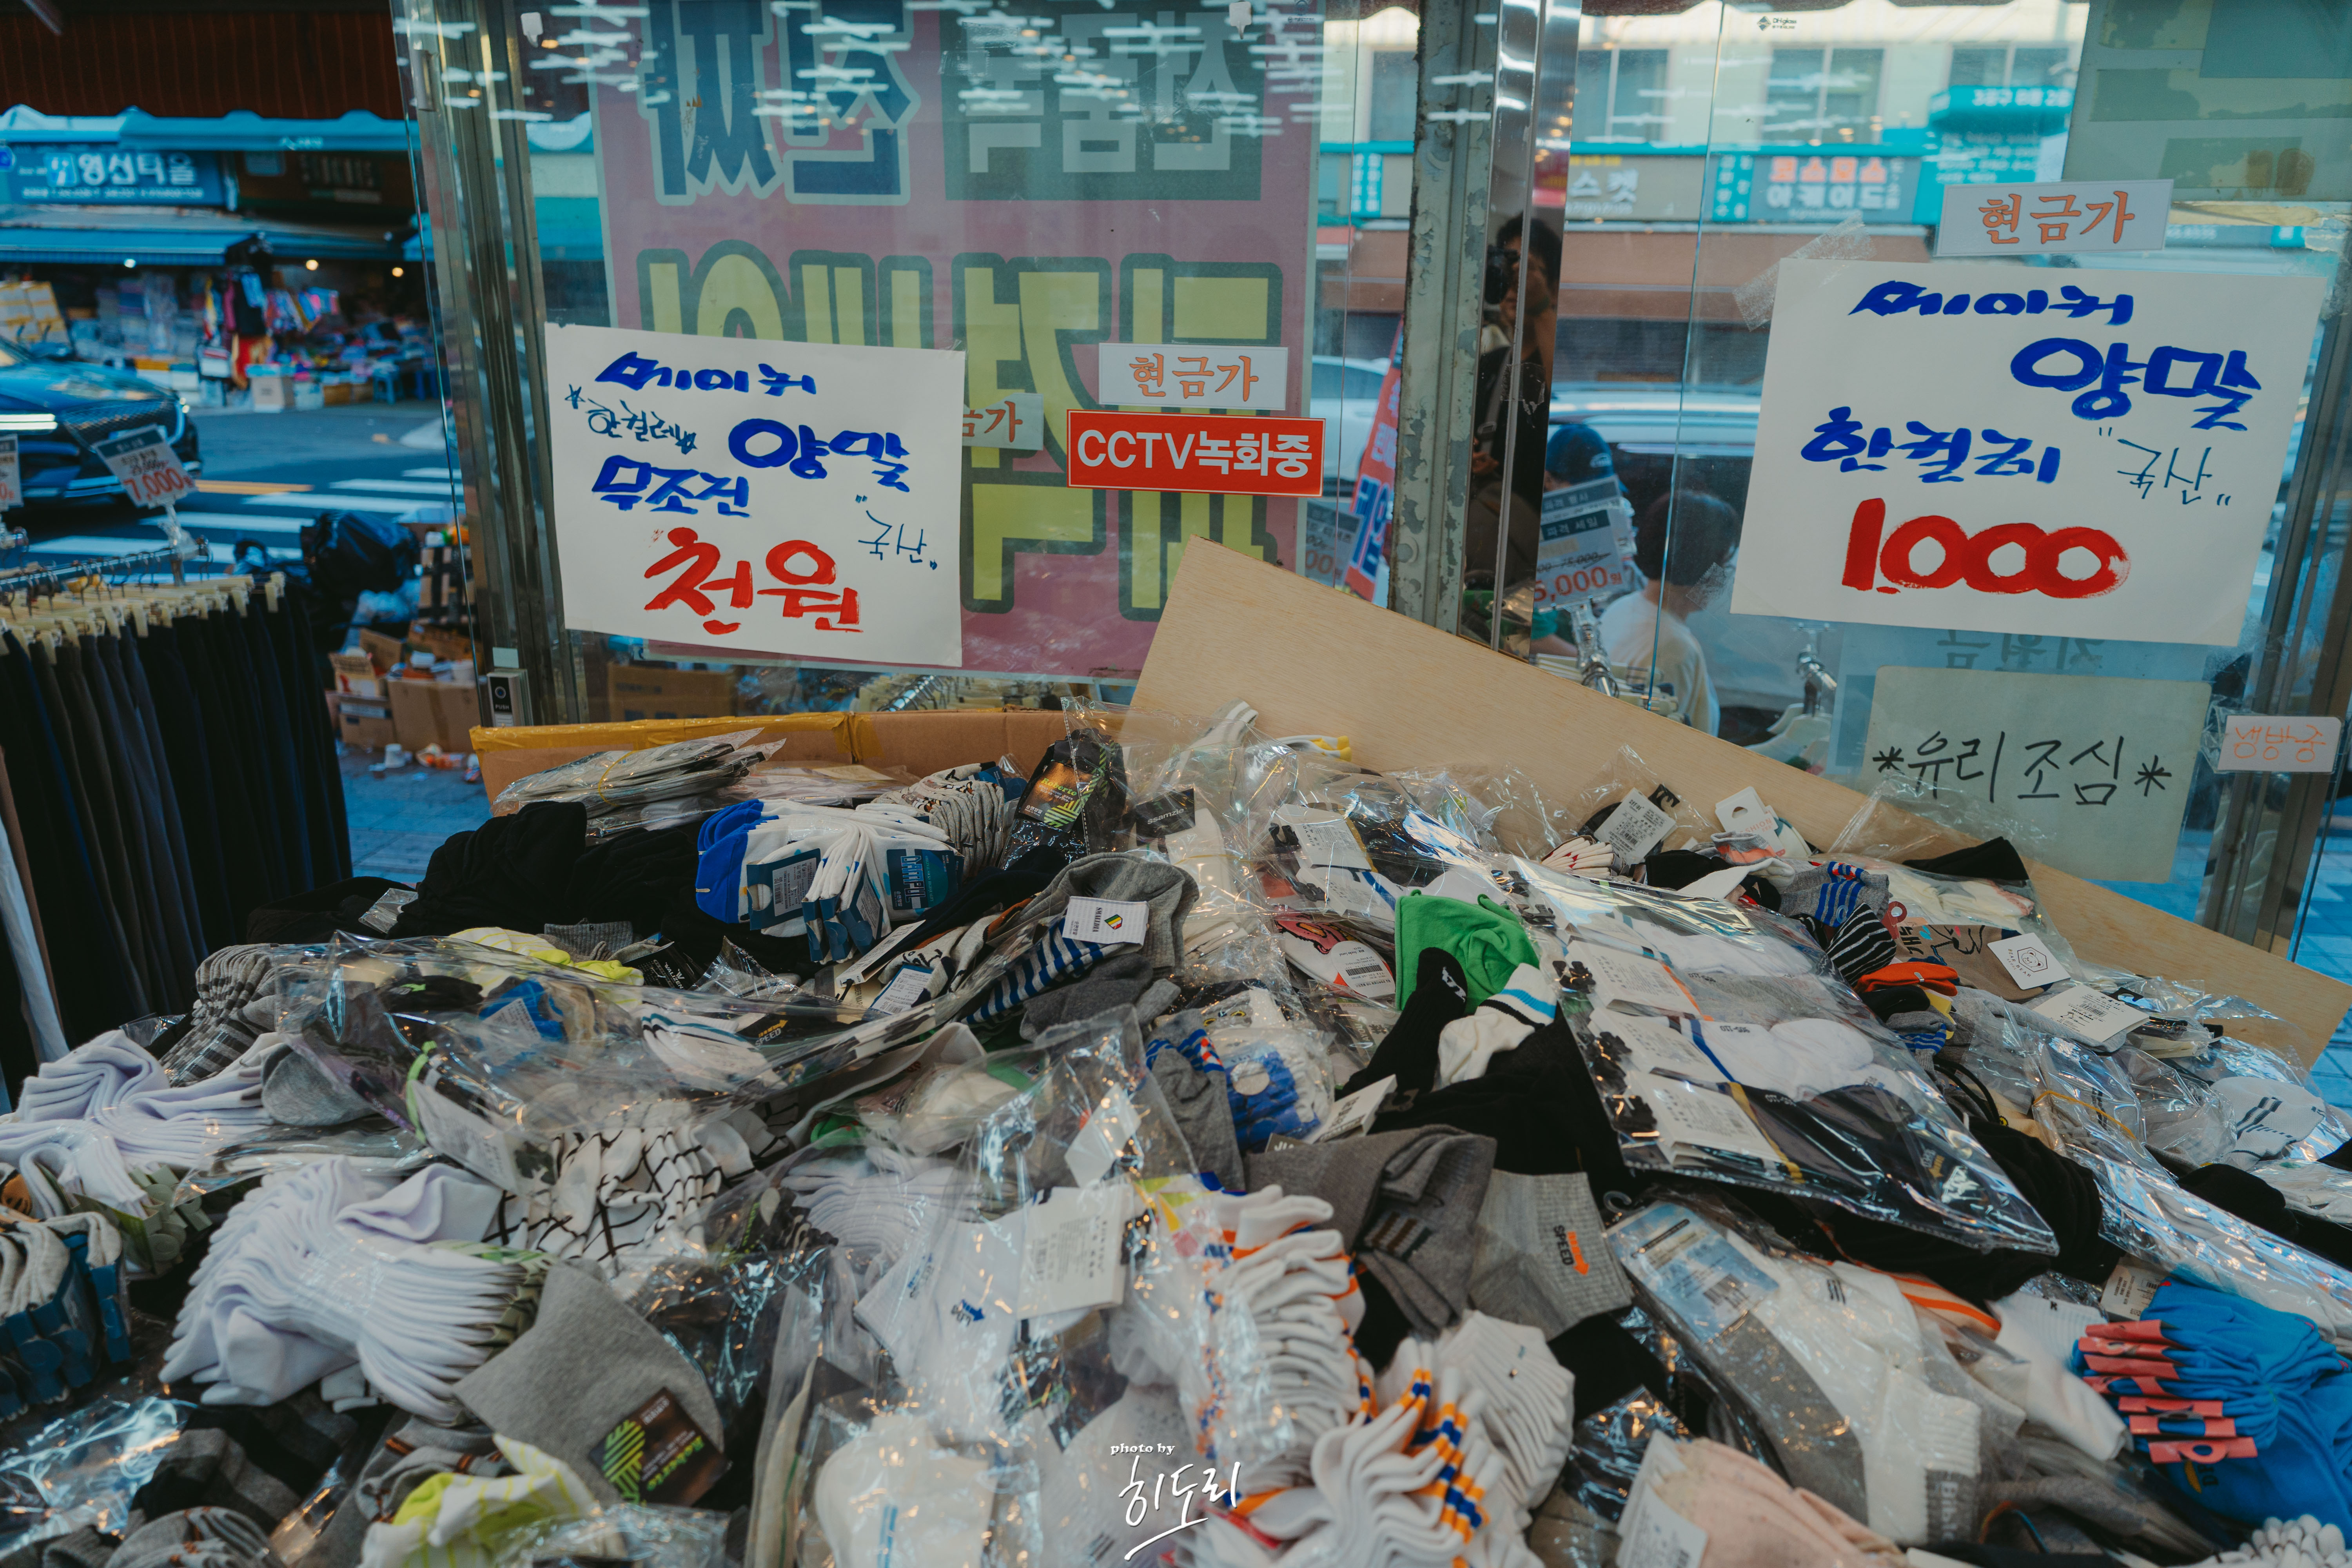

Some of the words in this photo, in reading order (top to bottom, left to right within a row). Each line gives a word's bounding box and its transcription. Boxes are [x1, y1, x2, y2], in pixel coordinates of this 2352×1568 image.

[1978, 191, 2135, 245] 현금가
[1129, 353, 1259, 402] 현금가
[2011, 337, 2261, 431] 양말
[728, 418, 909, 492] 양말
[1077, 429, 1313, 478] CCTV녹화중
[592, 454, 752, 518] 무조건
[644, 527, 864, 635] 천원
[1041, 777, 1077, 796] Roberto
[1908, 730, 2006, 803] 유리
[2017, 735, 2123, 806] 조심
[1026, 804, 1043, 815] 순면양말
[1553, 1225, 1573, 1266] SPEED
